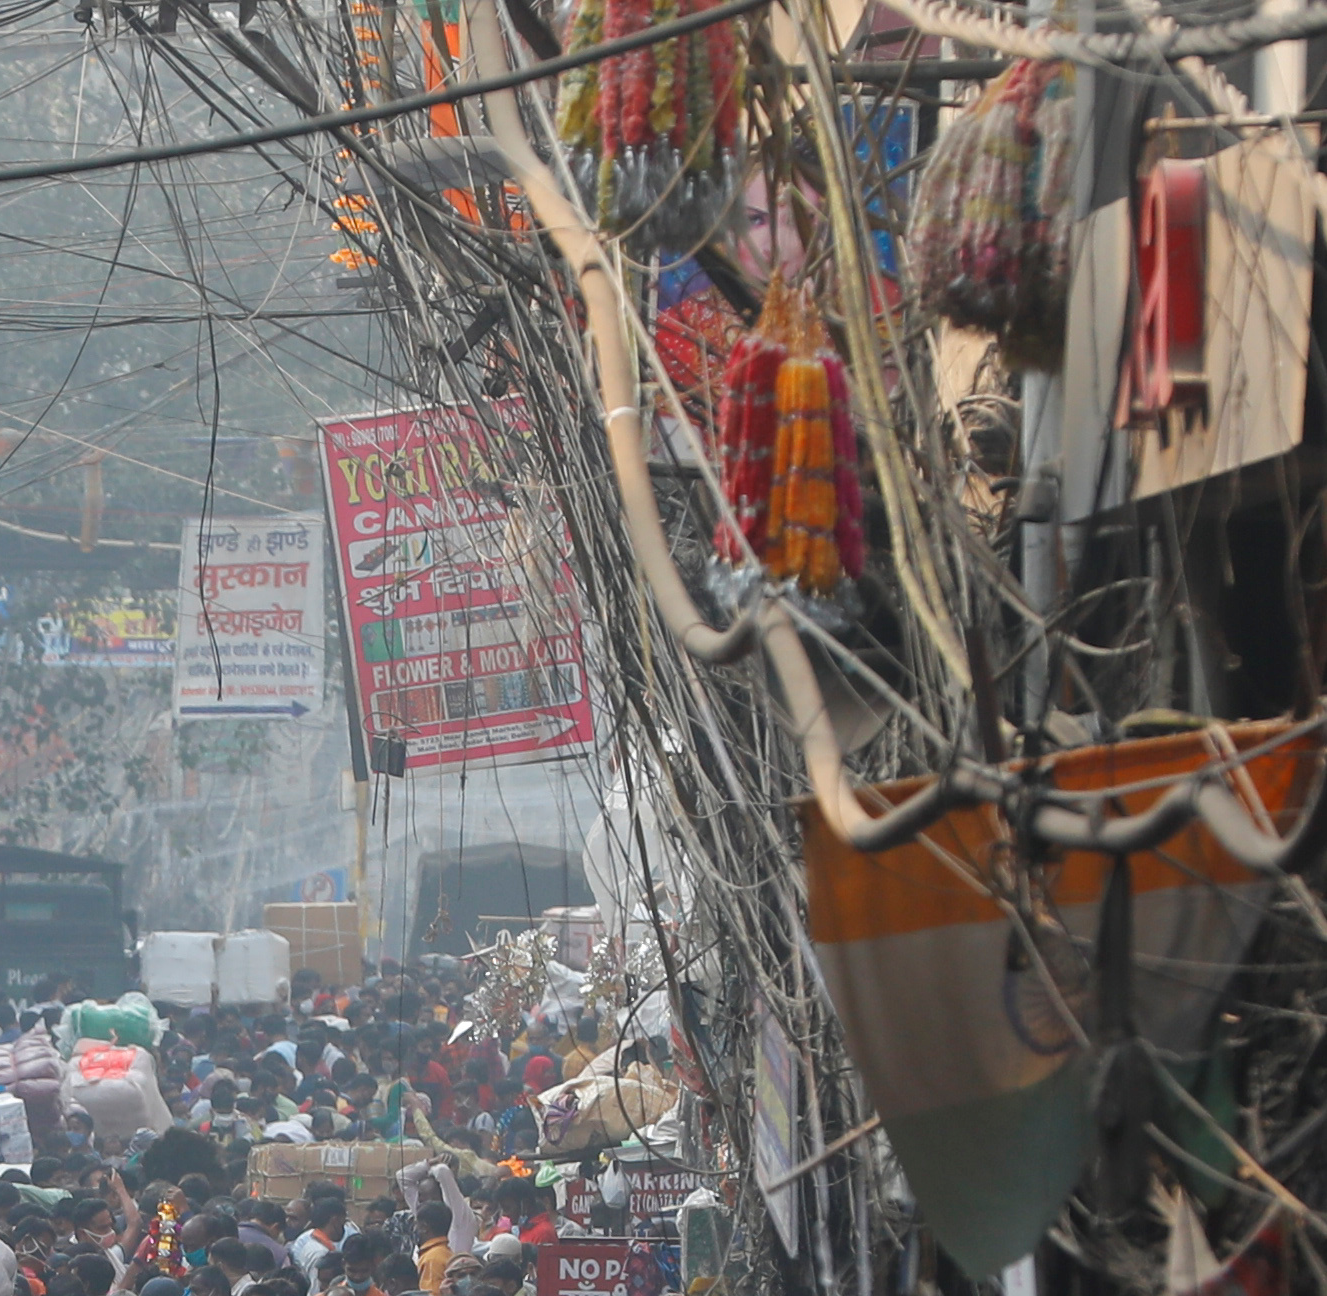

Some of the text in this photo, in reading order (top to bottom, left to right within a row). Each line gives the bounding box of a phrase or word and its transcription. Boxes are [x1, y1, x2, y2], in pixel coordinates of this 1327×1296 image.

[193, 562, 310, 600] मुस्कान
[373, 656, 455, 689] FLOWER
[559, 1258, 600, 1280] NO
